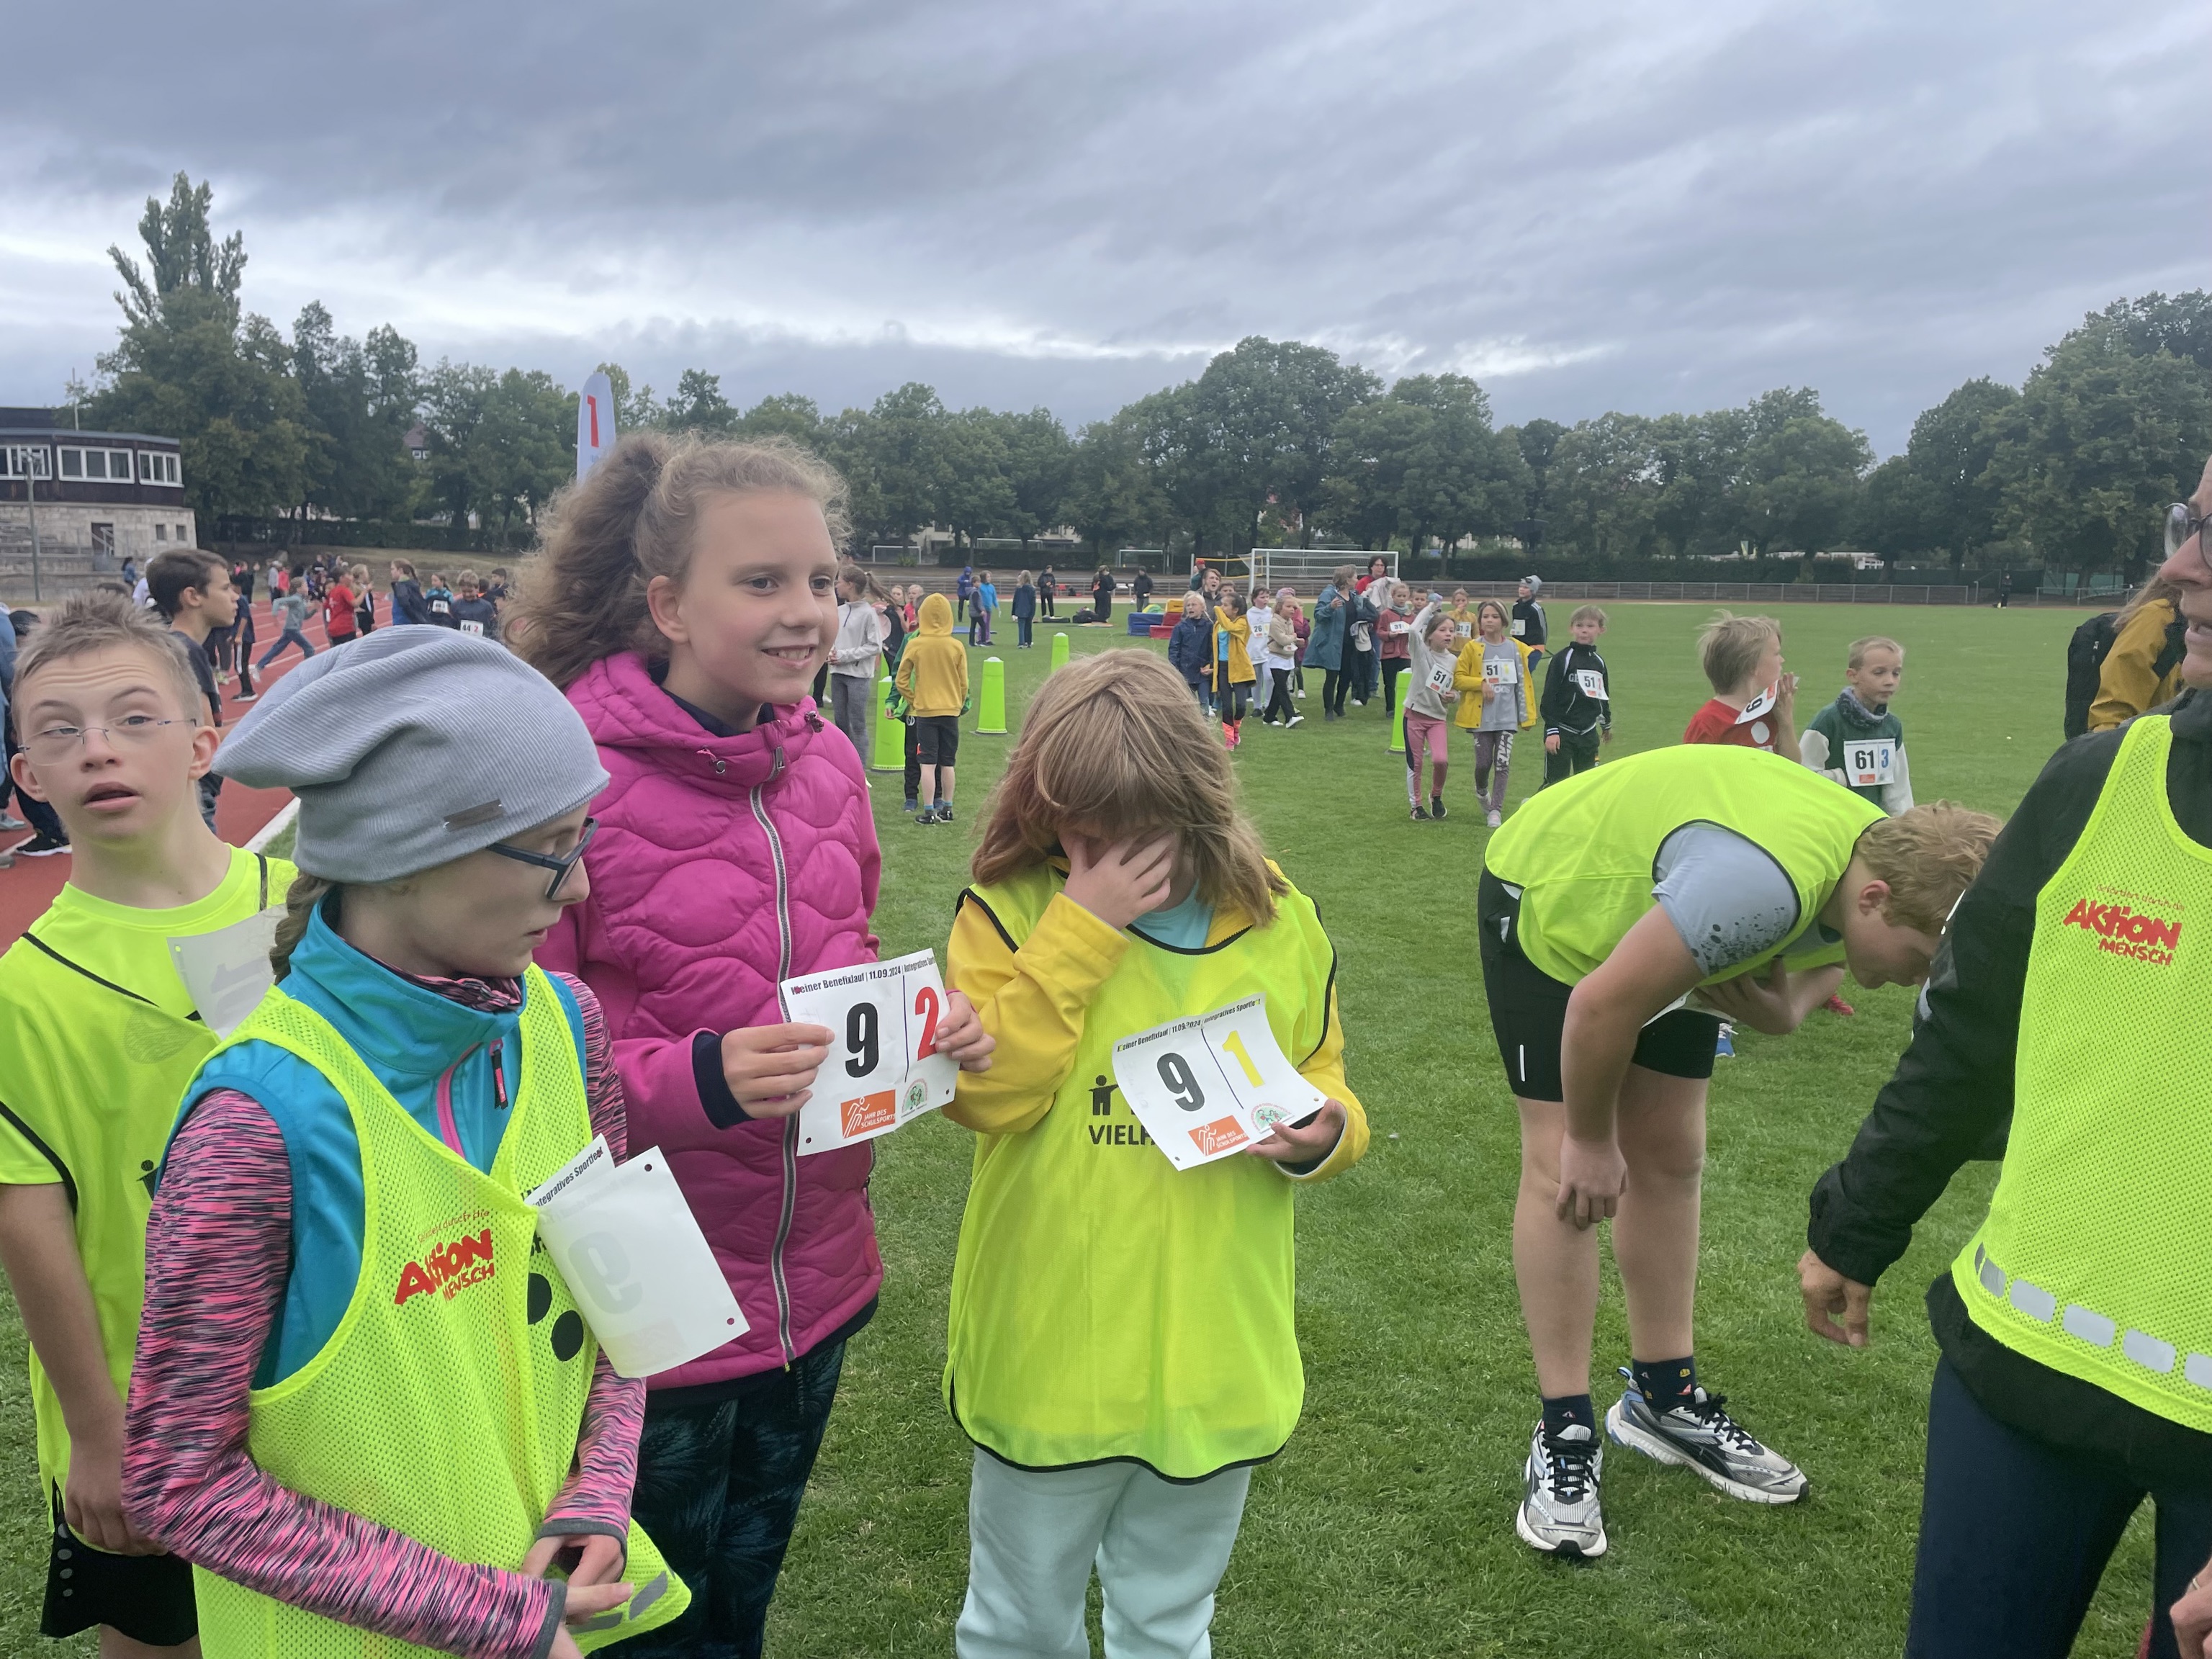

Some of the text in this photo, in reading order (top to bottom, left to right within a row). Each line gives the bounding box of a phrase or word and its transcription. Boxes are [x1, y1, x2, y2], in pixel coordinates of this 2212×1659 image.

[587, 395, 600, 448] 1
[1434, 670, 1447, 684] 51
[1486, 665, 1498, 676] 51
[1584, 675, 1596, 688] 51
[1855, 749, 1889, 770] 61 3
[2098, 938, 2173, 966] MENSCH
[822, 974, 865, 989] Benefixlauf
[868, 965, 901, 980] 11.09.2024
[845, 986, 940, 1079] 9 2
[1138, 1028, 1169, 1046] Benefixlauf
[1156, 1052, 1205, 1112] 9
[1222, 1030, 1266, 1089] 1
[863, 1108, 887, 1121] JAHR DES
